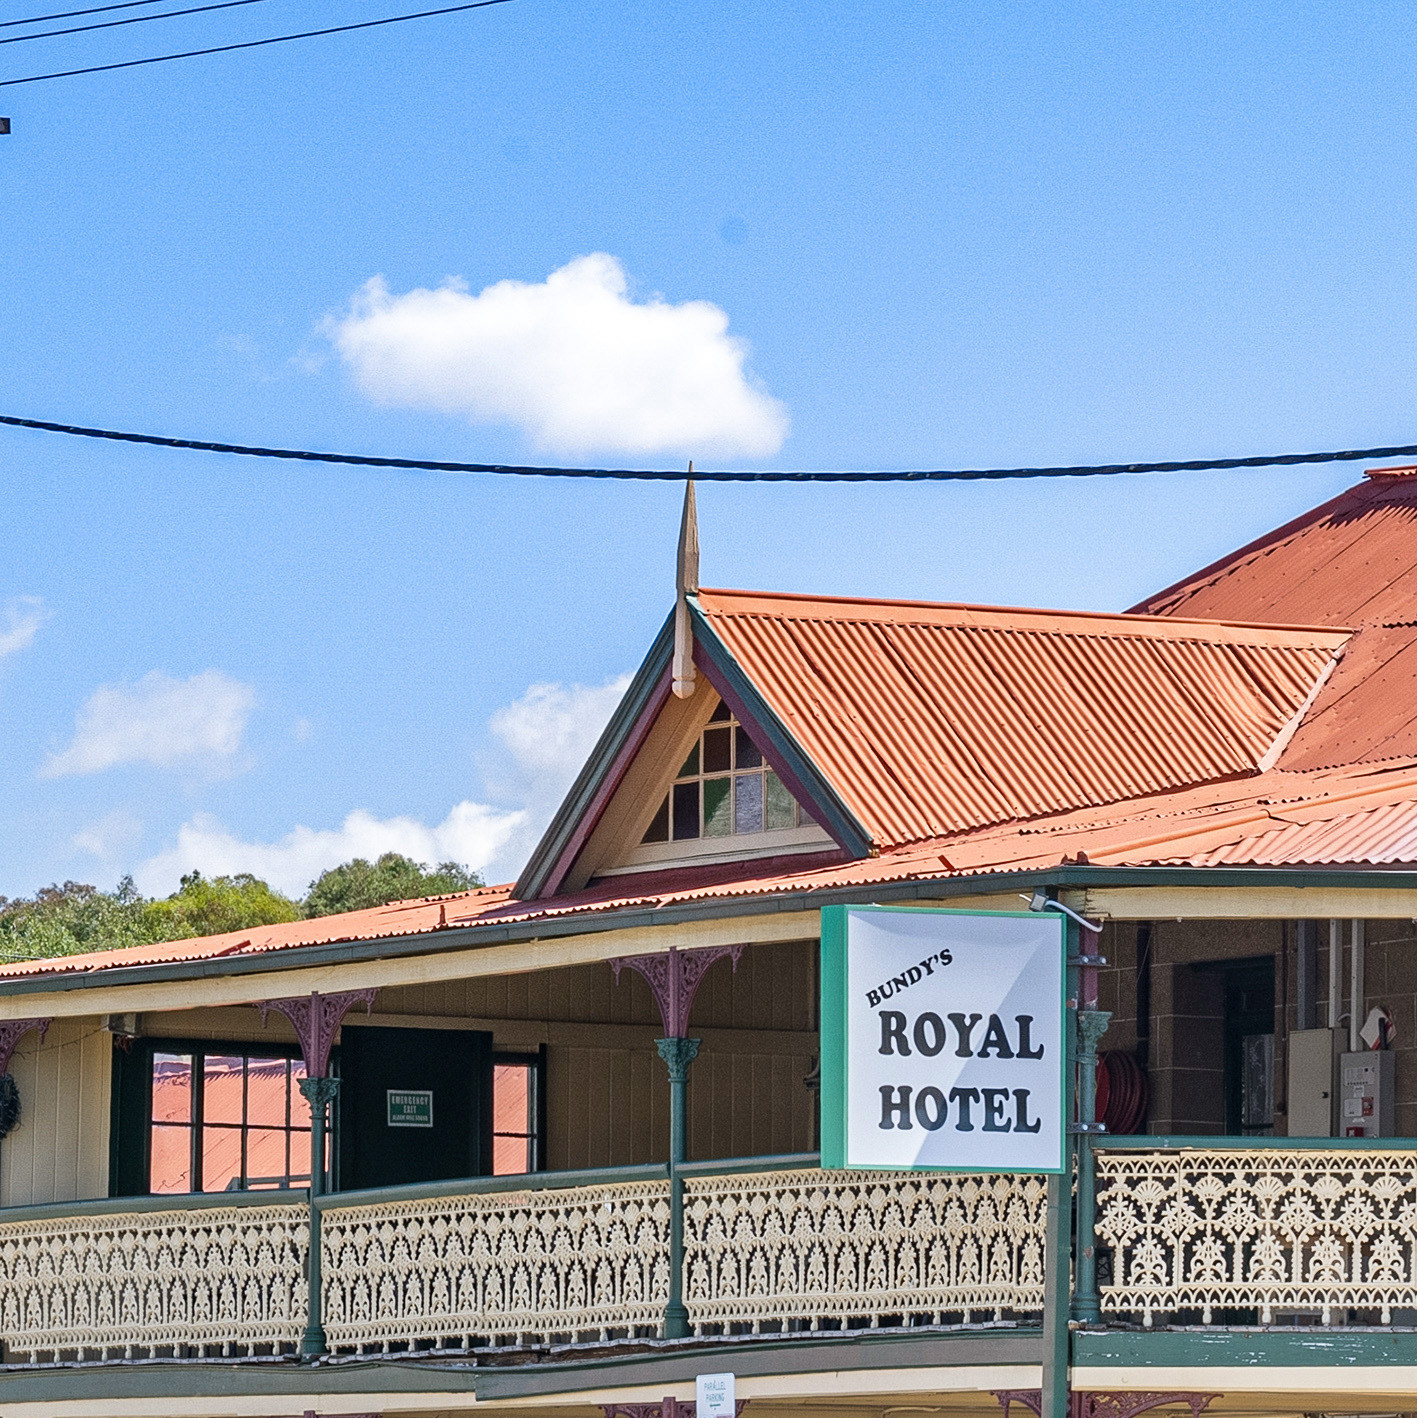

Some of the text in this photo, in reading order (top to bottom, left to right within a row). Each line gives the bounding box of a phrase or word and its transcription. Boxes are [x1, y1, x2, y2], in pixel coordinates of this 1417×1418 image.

[865, 948, 954, 1009] BUNDY'S
[878, 1010, 1045, 1061] ROYAL
[391, 1095, 429, 1106] EMERGENCY
[403, 1105, 417, 1114] EXIT
[878, 1084, 1042, 1134] HOTEL
